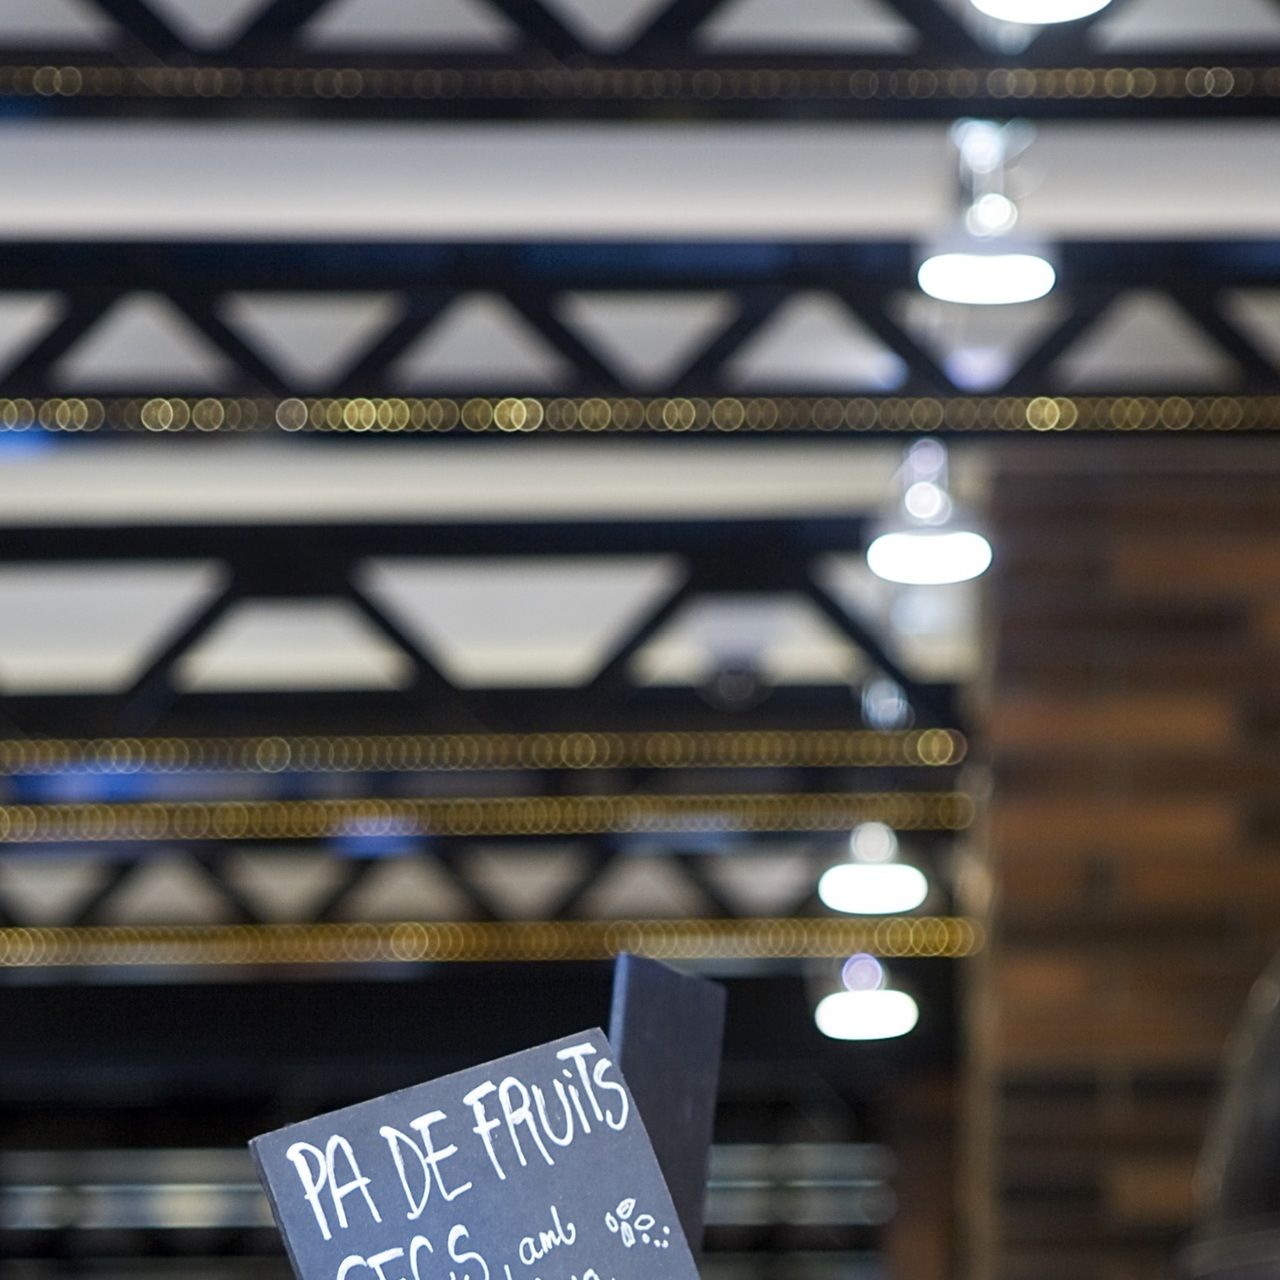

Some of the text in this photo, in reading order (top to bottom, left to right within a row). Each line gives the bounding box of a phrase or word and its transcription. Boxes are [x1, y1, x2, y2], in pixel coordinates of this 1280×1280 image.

[286, 1134, 382, 1240] PA
[380, 1110, 472, 1220] DE
[519, 1205, 576, 1265] amb
